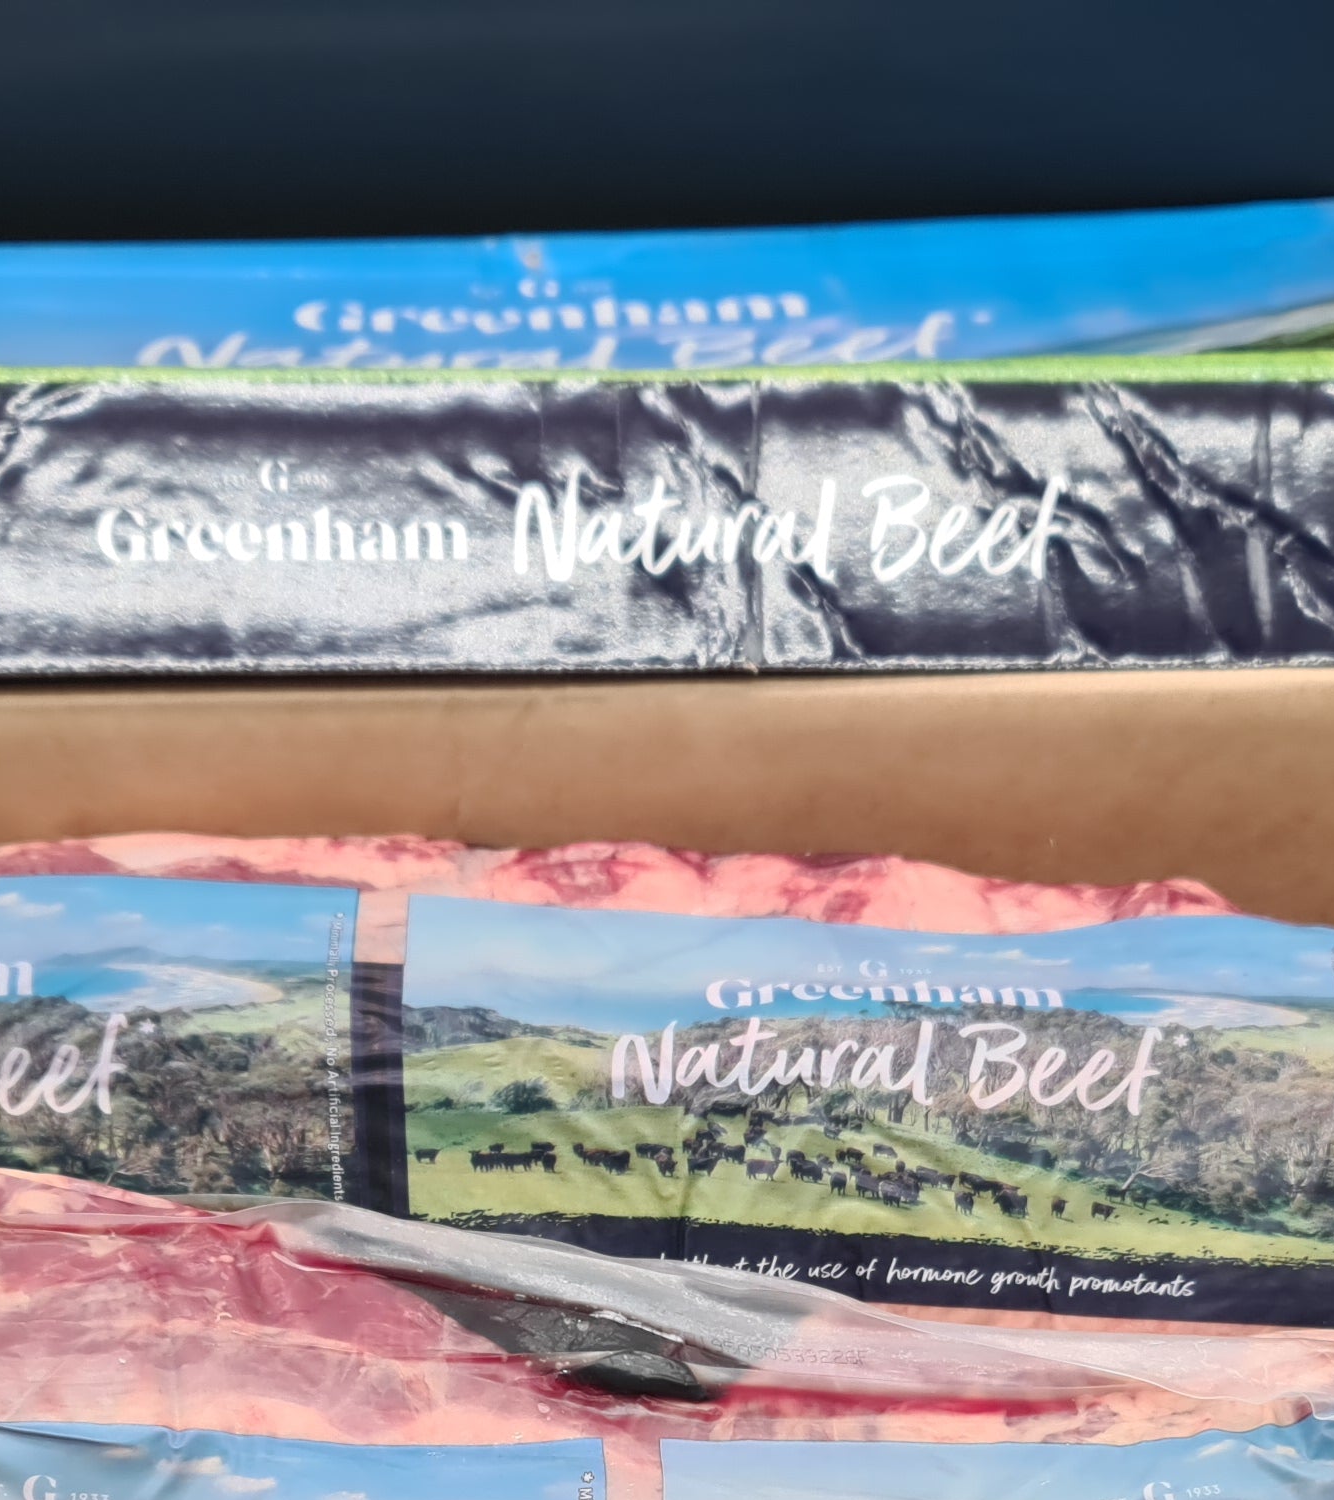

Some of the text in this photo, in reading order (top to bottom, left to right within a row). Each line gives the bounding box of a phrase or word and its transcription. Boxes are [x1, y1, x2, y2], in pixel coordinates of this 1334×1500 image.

[294, 292, 809, 334] Greenham
[97, 467, 1071, 582] Greenham Natural Beef
[706, 978, 1064, 1010] Greenham
[326, 1047, 339, 1066] No
[610, 1016, 1163, 1117] Natural Beef
[326, 1070, 342, 1128] Artificial
[327, 1131, 345, 1202] Ingredients
[757, 1255, 800, 1280] the
[808, 1265, 848, 1279] use
[855, 1258, 878, 1281] of
[886, 1257, 983, 1285] hormone
[990, 1266, 1061, 1294] growth
[1068, 1273, 1196, 1298] promotants
[1186, 1485, 1221, 1498] 1933
